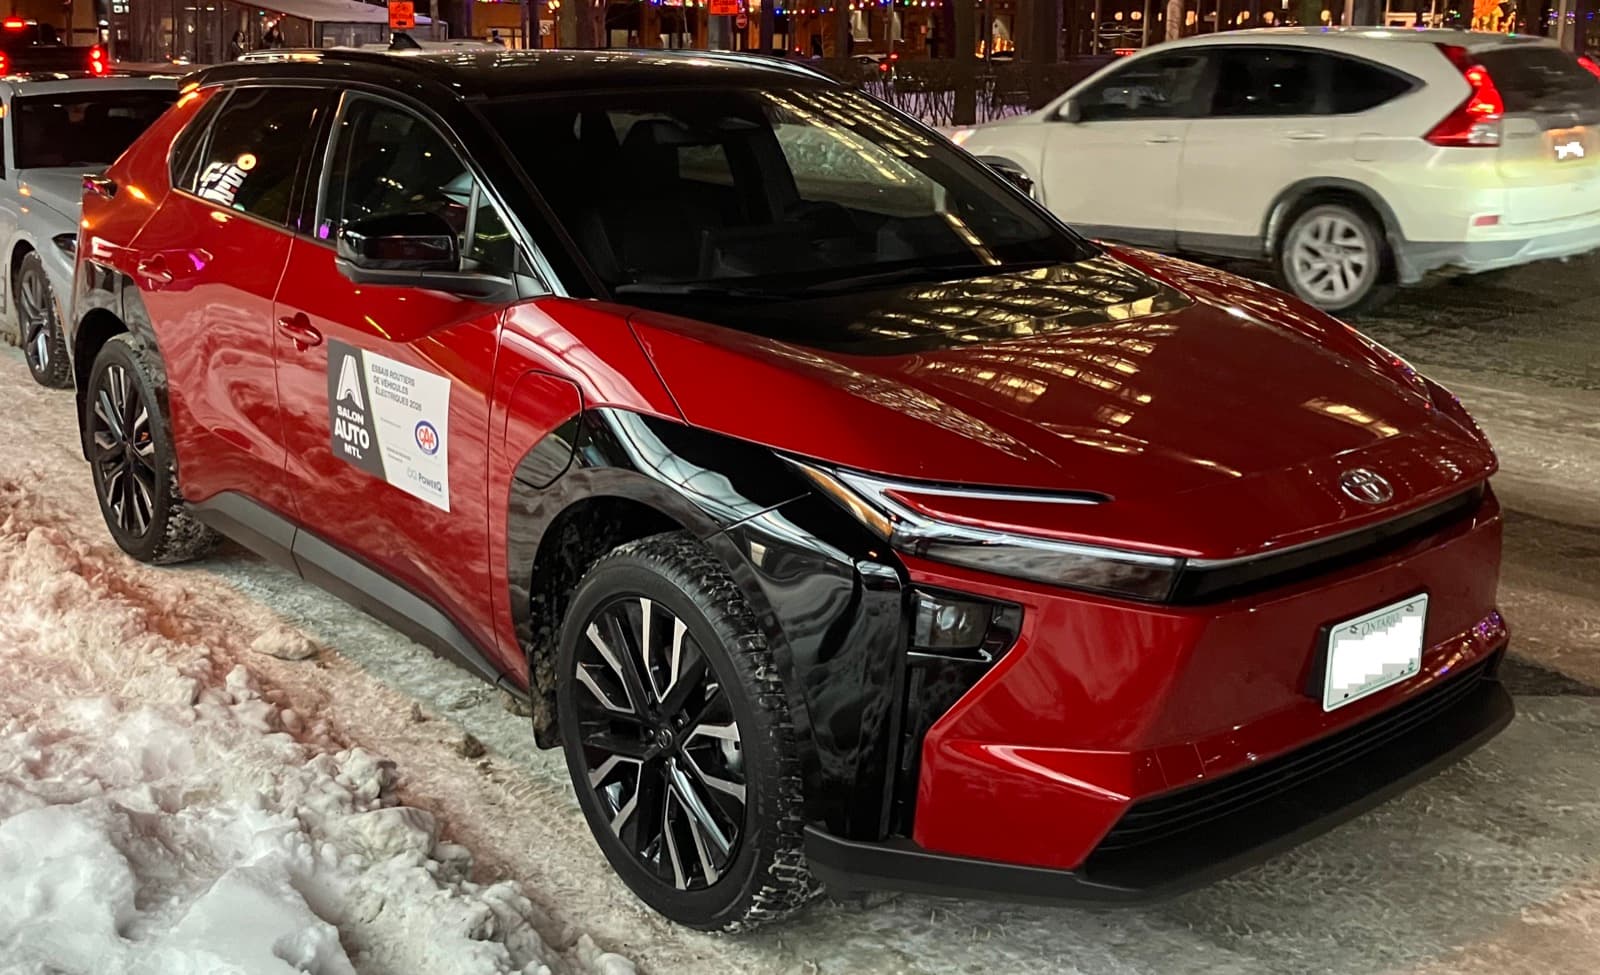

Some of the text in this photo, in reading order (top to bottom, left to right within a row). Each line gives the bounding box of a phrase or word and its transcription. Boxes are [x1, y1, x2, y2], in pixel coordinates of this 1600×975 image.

[337, 405, 364, 425] SALON
[334, 417, 370, 449] AUTO
[418, 428, 435, 448] CAA
[344, 443, 363, 460] MTL
